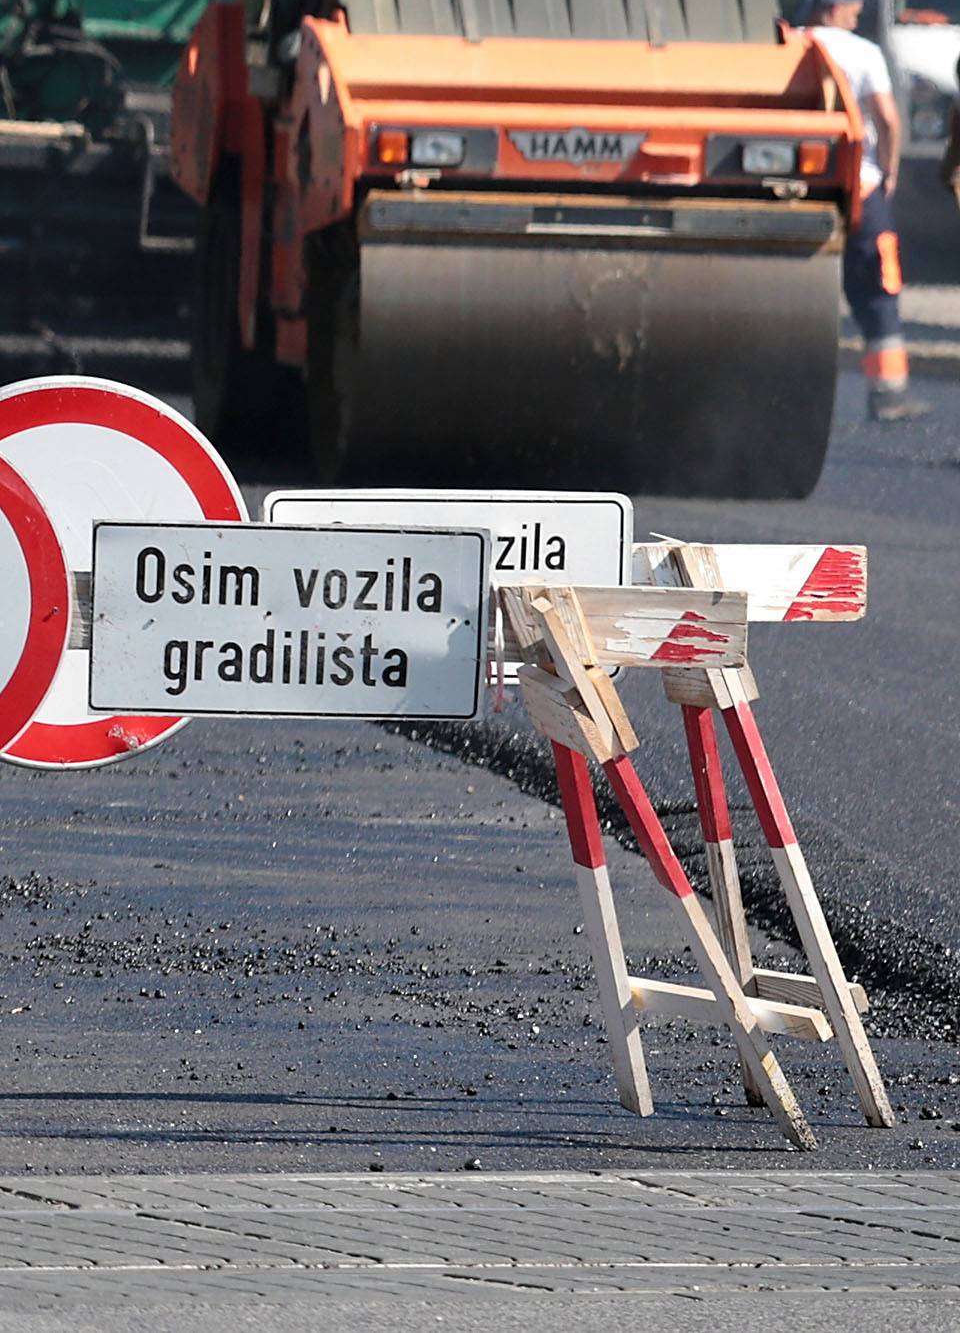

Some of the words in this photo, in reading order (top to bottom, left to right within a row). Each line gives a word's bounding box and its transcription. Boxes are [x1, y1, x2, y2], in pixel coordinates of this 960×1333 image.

[530, 135, 622, 158] HAMM
[495, 523, 567, 571] zila
[136, 546, 260, 607] Osim
[294, 557, 443, 613] vozila
[163, 629, 408, 697] gradilišta
